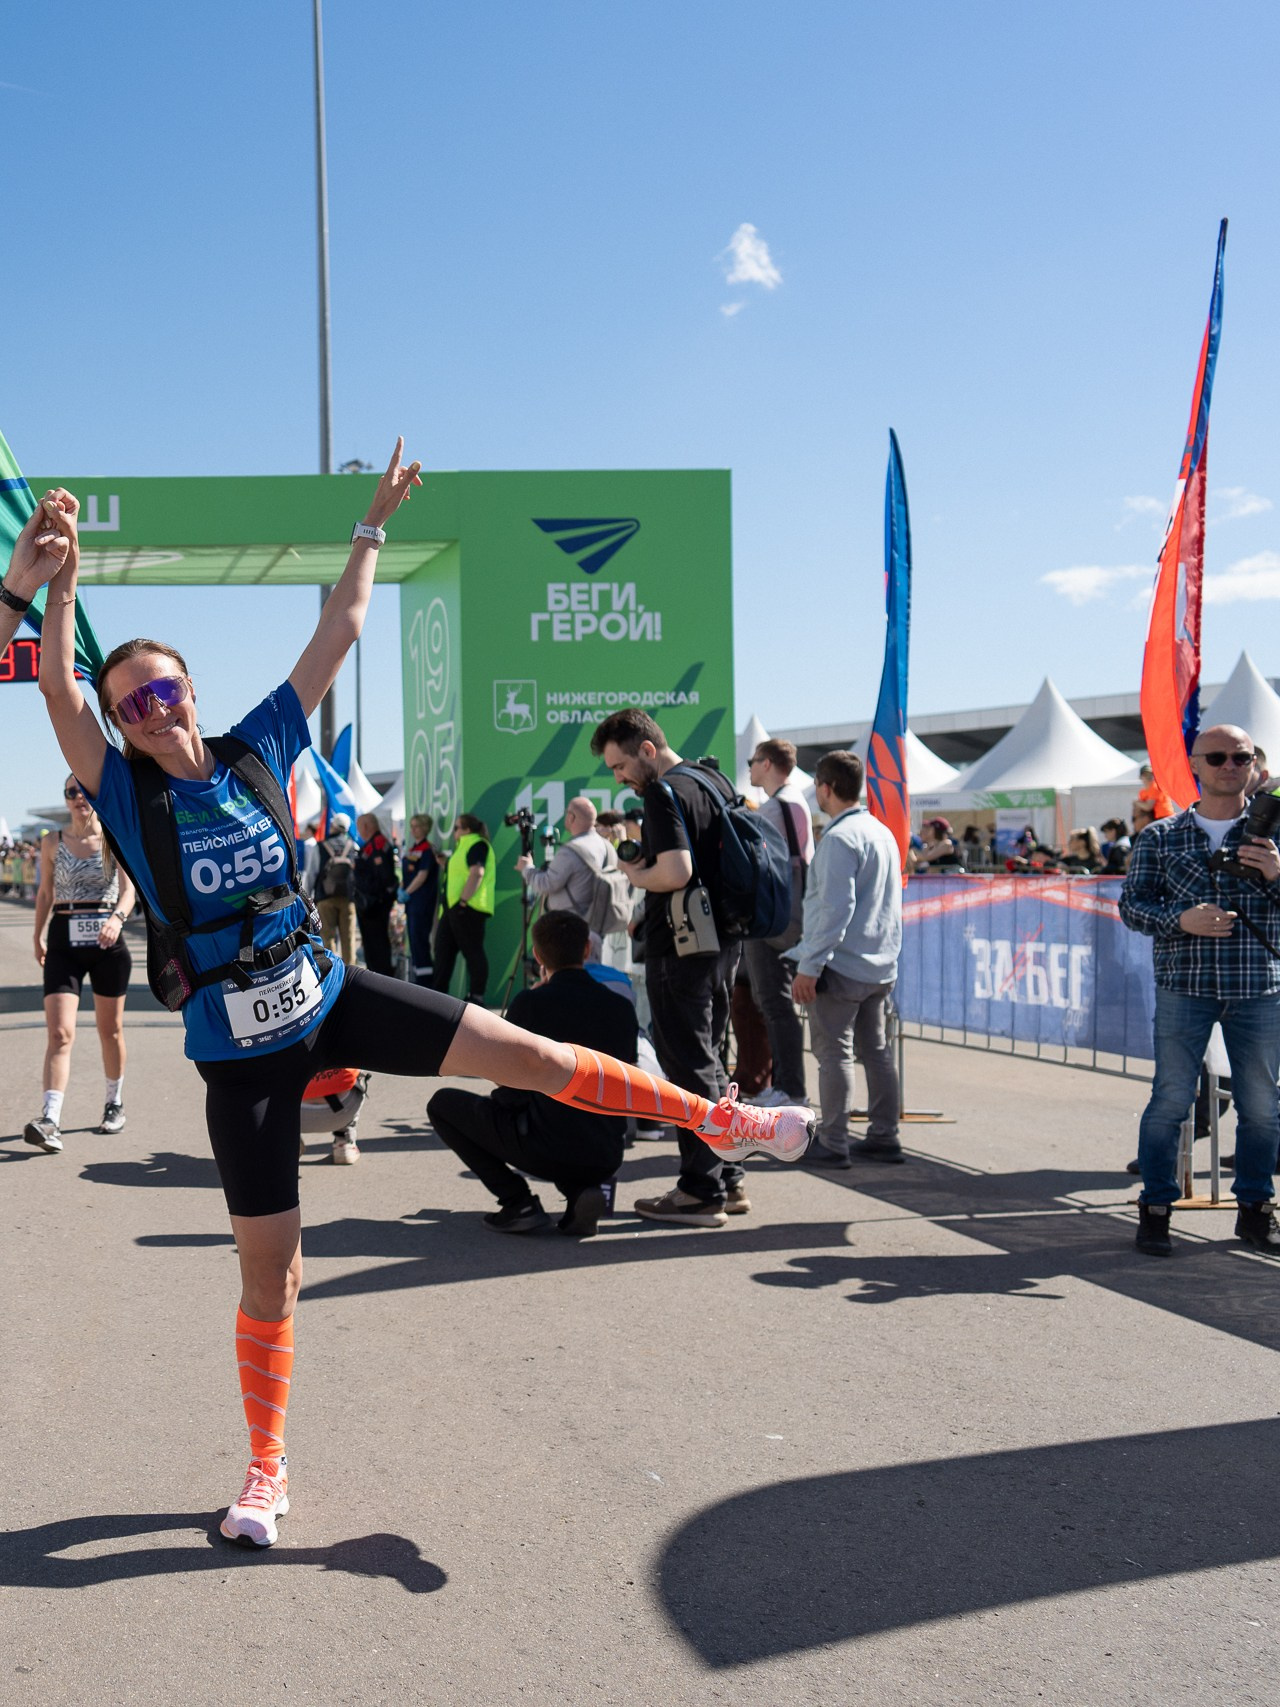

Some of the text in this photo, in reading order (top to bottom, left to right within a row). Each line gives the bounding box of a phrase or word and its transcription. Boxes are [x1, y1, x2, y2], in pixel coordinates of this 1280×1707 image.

[546, 582, 645, 614] БЕГИ,
[546, 691, 700, 706] НИЖЕГОРОДСКАЯ
[546, 710, 618, 723] ОБЛАС
[182, 815, 273, 854] ПЕЙСМЕЙКЕР
[190, 832, 285, 894] 0:55
[253, 980, 306, 1023] 0:55
